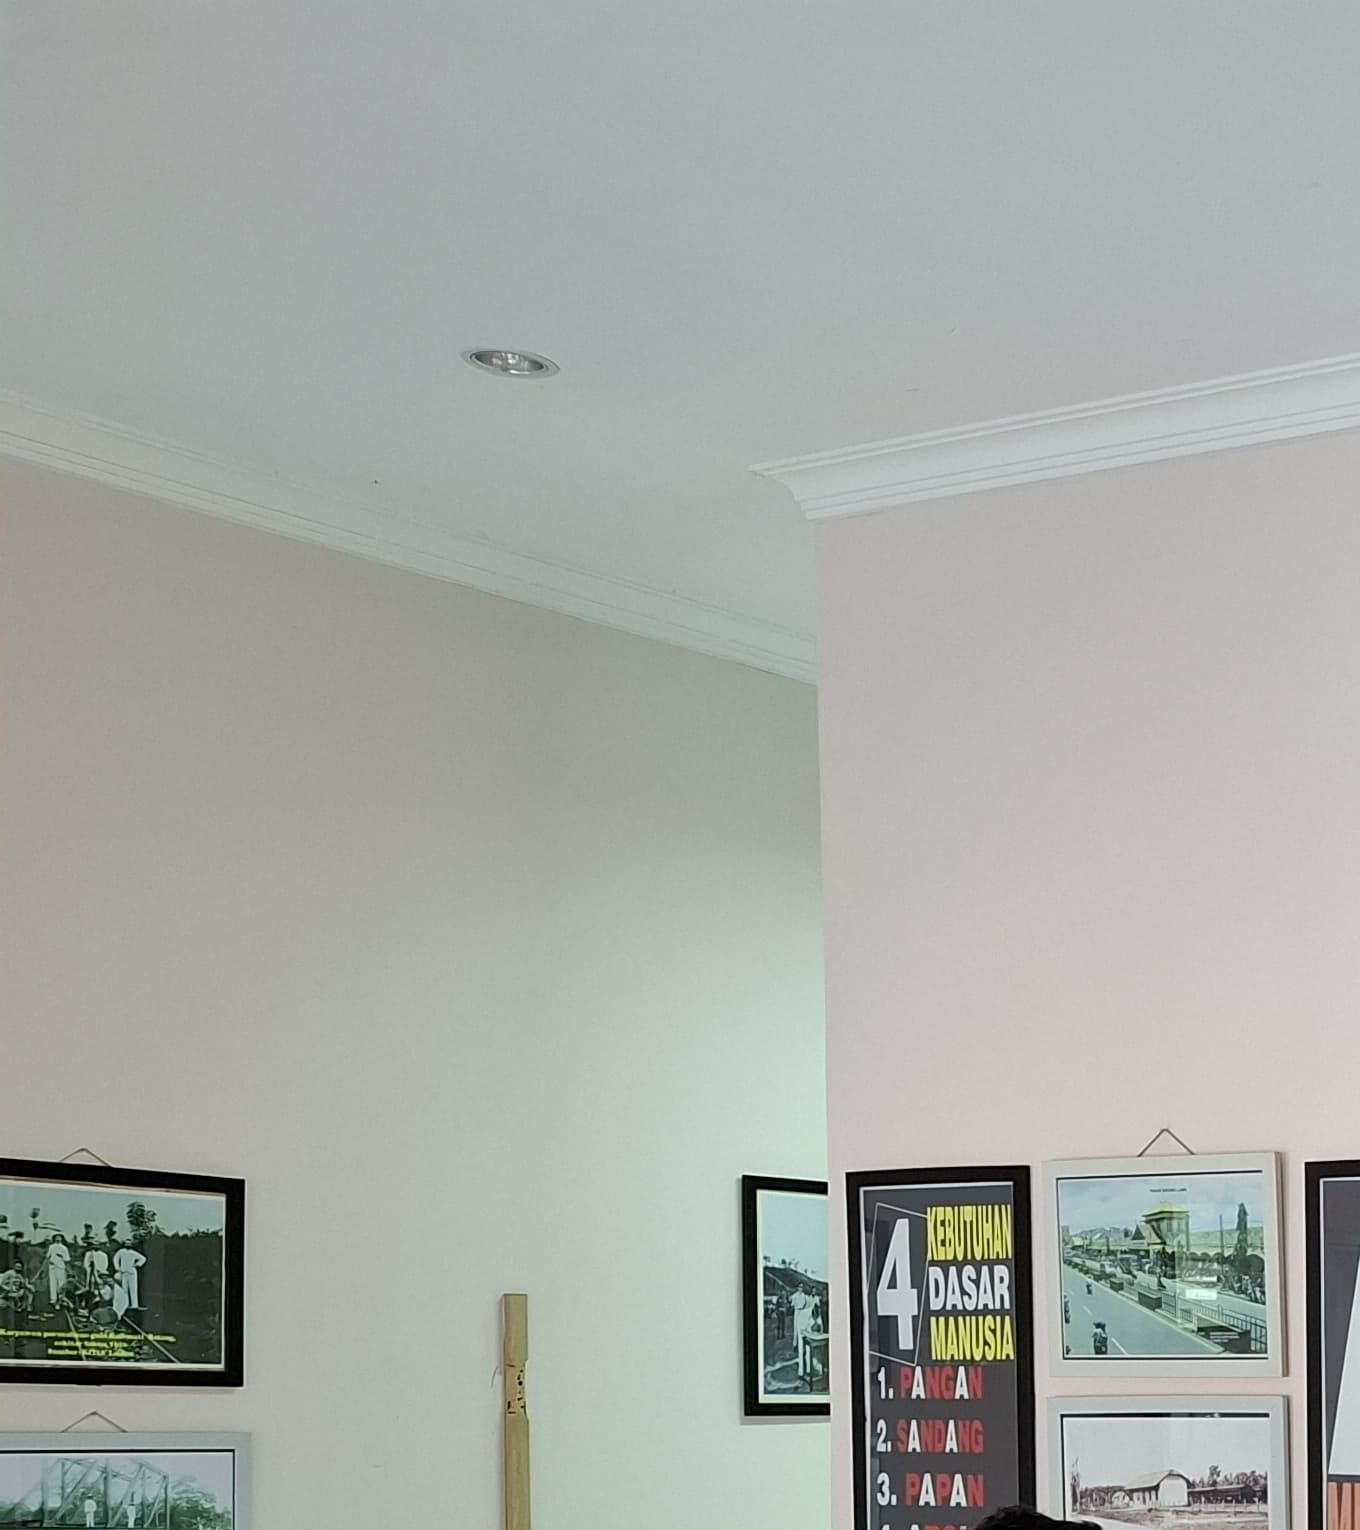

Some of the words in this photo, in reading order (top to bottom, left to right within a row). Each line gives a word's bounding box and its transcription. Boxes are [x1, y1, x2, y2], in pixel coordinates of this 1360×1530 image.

[927, 1204, 1012, 1262] KEBUTUHAN
[877, 1218, 918, 1350] 4
[928, 1265, 1010, 1311] DASAR
[930, 1315, 1014, 1361] MANUSIA
[877, 1366, 894, 1400] 1.
[899, 1366, 983, 1399] PANGAN
[876, 1419, 892, 1453] 2.
[896, 1419, 984, 1454] SANDANG
[876, 1473, 897, 1506] 3.
[905, 1472, 984, 1507] PAPAN
